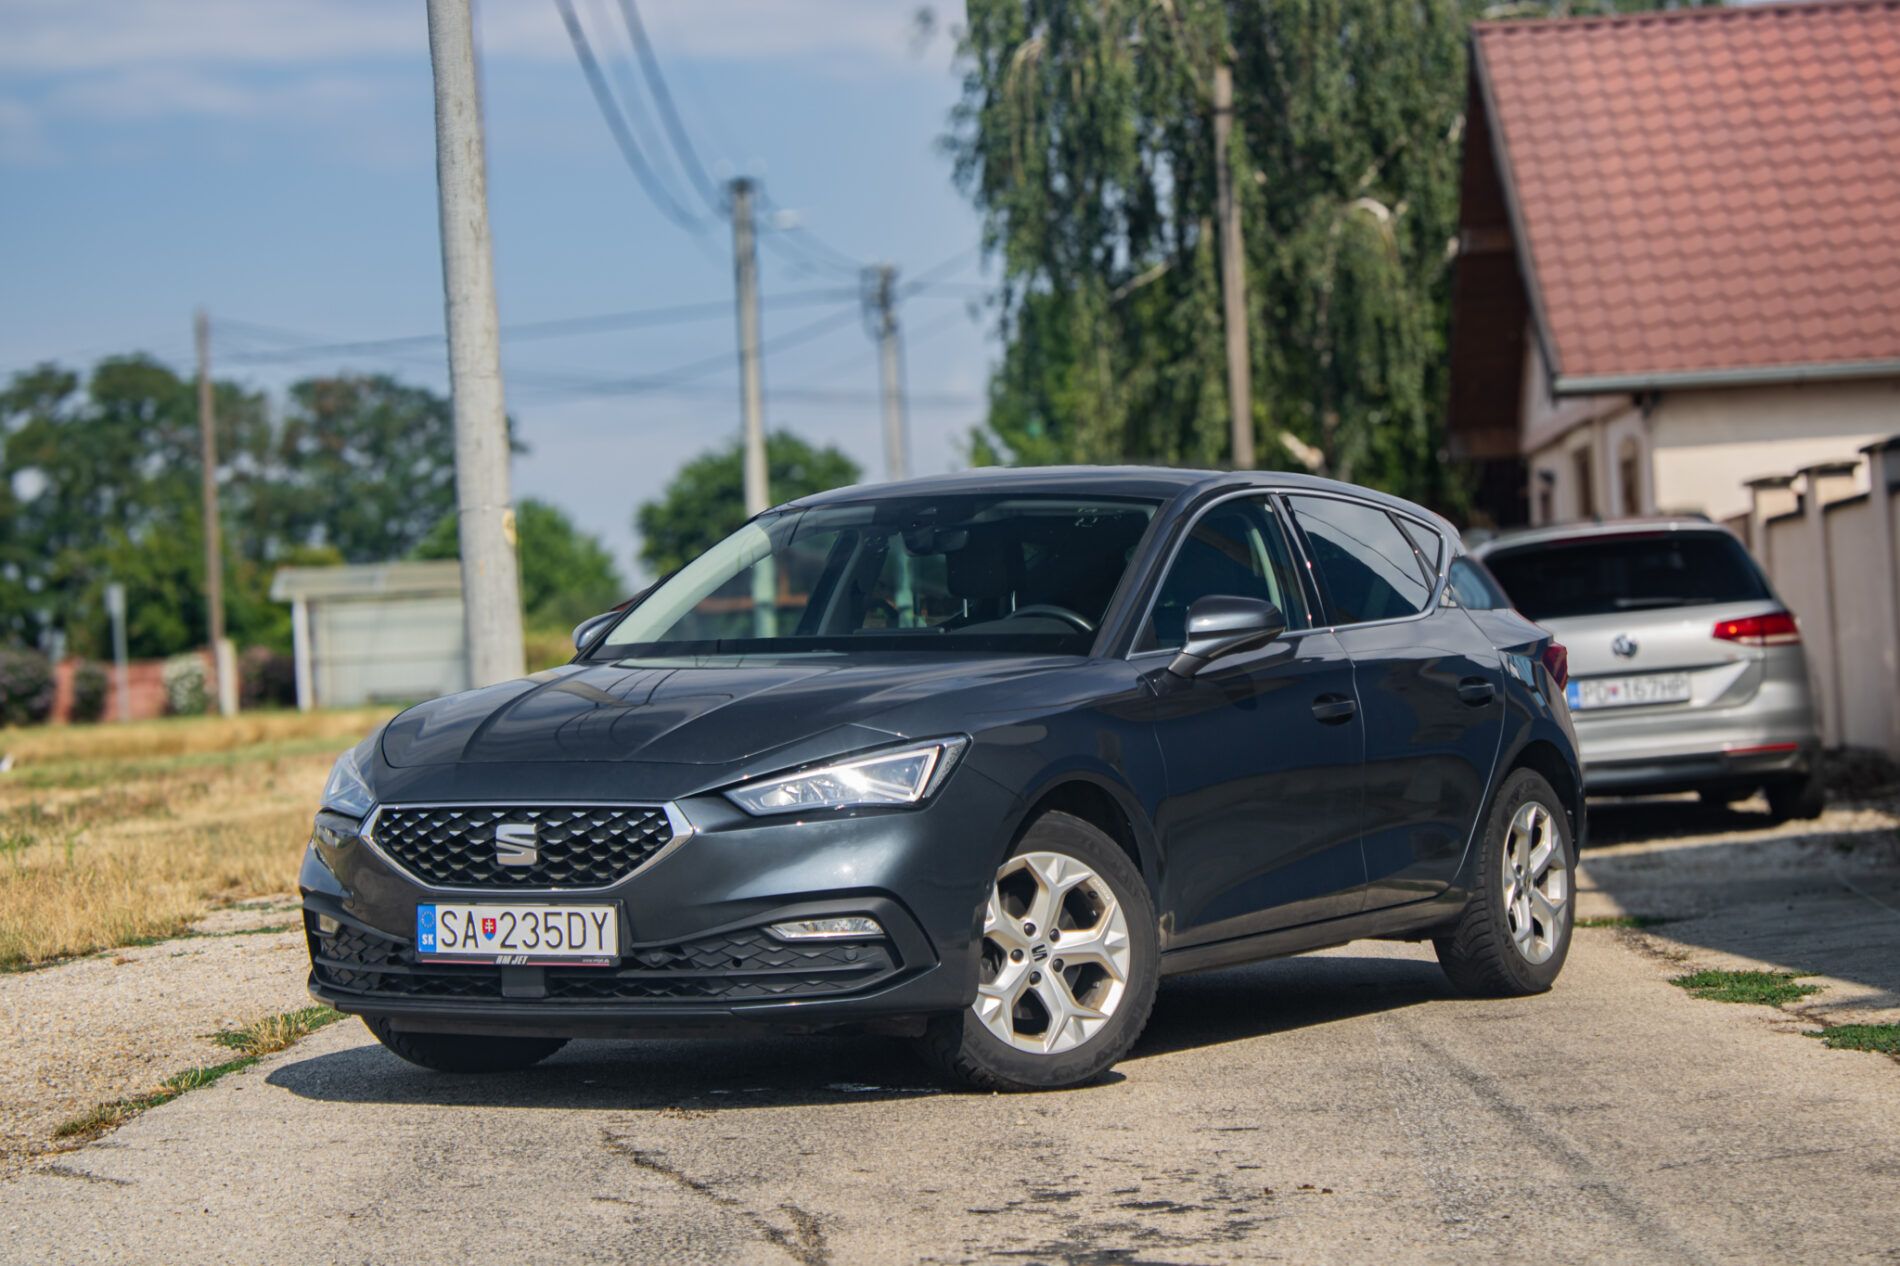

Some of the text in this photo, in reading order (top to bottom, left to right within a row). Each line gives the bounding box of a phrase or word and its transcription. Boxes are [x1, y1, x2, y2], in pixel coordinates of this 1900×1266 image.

[422, 933, 434, 945] SK
[441, 910, 609, 950] SA 235DY
